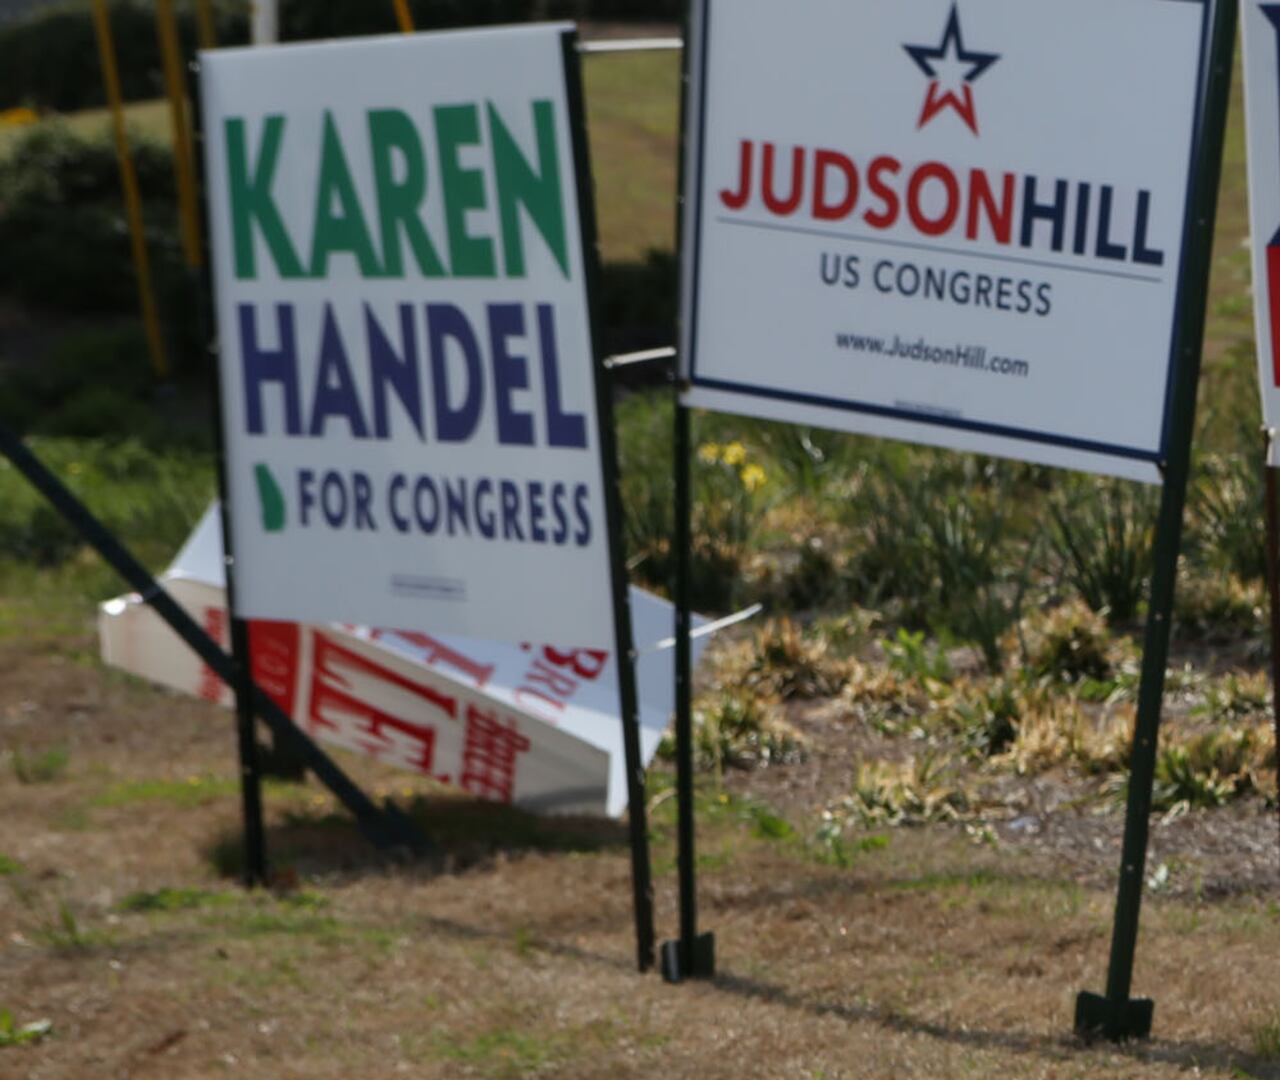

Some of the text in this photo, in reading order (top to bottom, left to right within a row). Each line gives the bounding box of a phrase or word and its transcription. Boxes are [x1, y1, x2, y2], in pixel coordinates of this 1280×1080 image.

[224, 100, 570, 281] KAREN
[820, 252, 1052, 317] US CONGRESS
[237, 300, 588, 449] HANDEL
[835, 329, 1029, 377] www.JudsonHill.com
[298, 469, 592, 547] FOR CONGRESS
